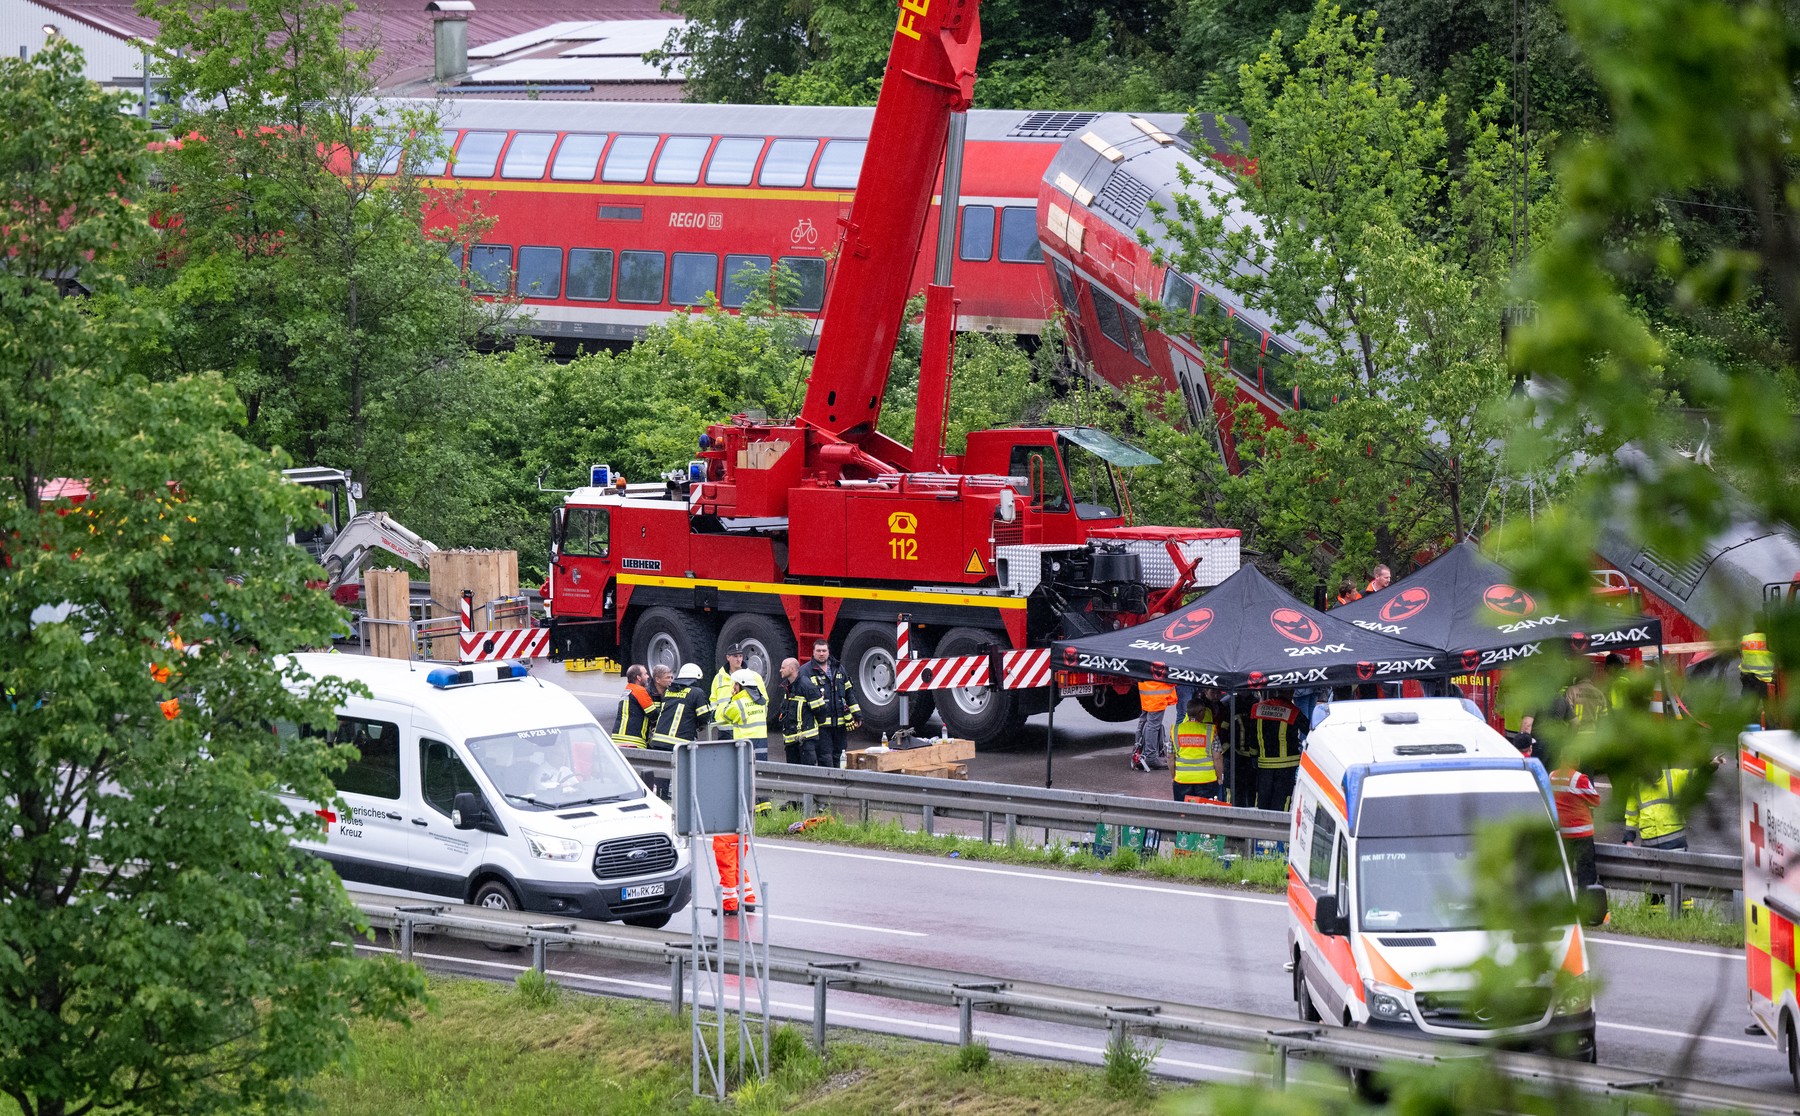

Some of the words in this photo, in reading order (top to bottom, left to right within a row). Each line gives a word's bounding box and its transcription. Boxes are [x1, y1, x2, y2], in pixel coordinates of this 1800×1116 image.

[668, 211, 706, 229] REGIO
[709, 213, 722, 228] DB
[888, 537, 918, 561] 112
[622, 558, 661, 570] LIEBHERR
[1351, 619, 1407, 635] 24MX
[1497, 613, 1569, 634] 24MX
[1590, 626, 1651, 647] 24MX
[1128, 639, 1190, 655] 24MX
[1283, 643, 1354, 657] 24MX
[1481, 641, 1544, 665] 24MX
[1078, 653, 1130, 673] 24MX
[1375, 656, 1437, 675] 24MX
[1167, 667, 1219, 687] 24MX
[1267, 667, 1329, 687] 24MX
[340, 825, 363, 838] Kreuz
[1372, 853, 1385, 861] MIT
[1386, 852, 1406, 861] 71/70
[626, 888, 637, 899] WM
[640, 886, 650, 896] RK
[651, 884, 664, 894] 225
